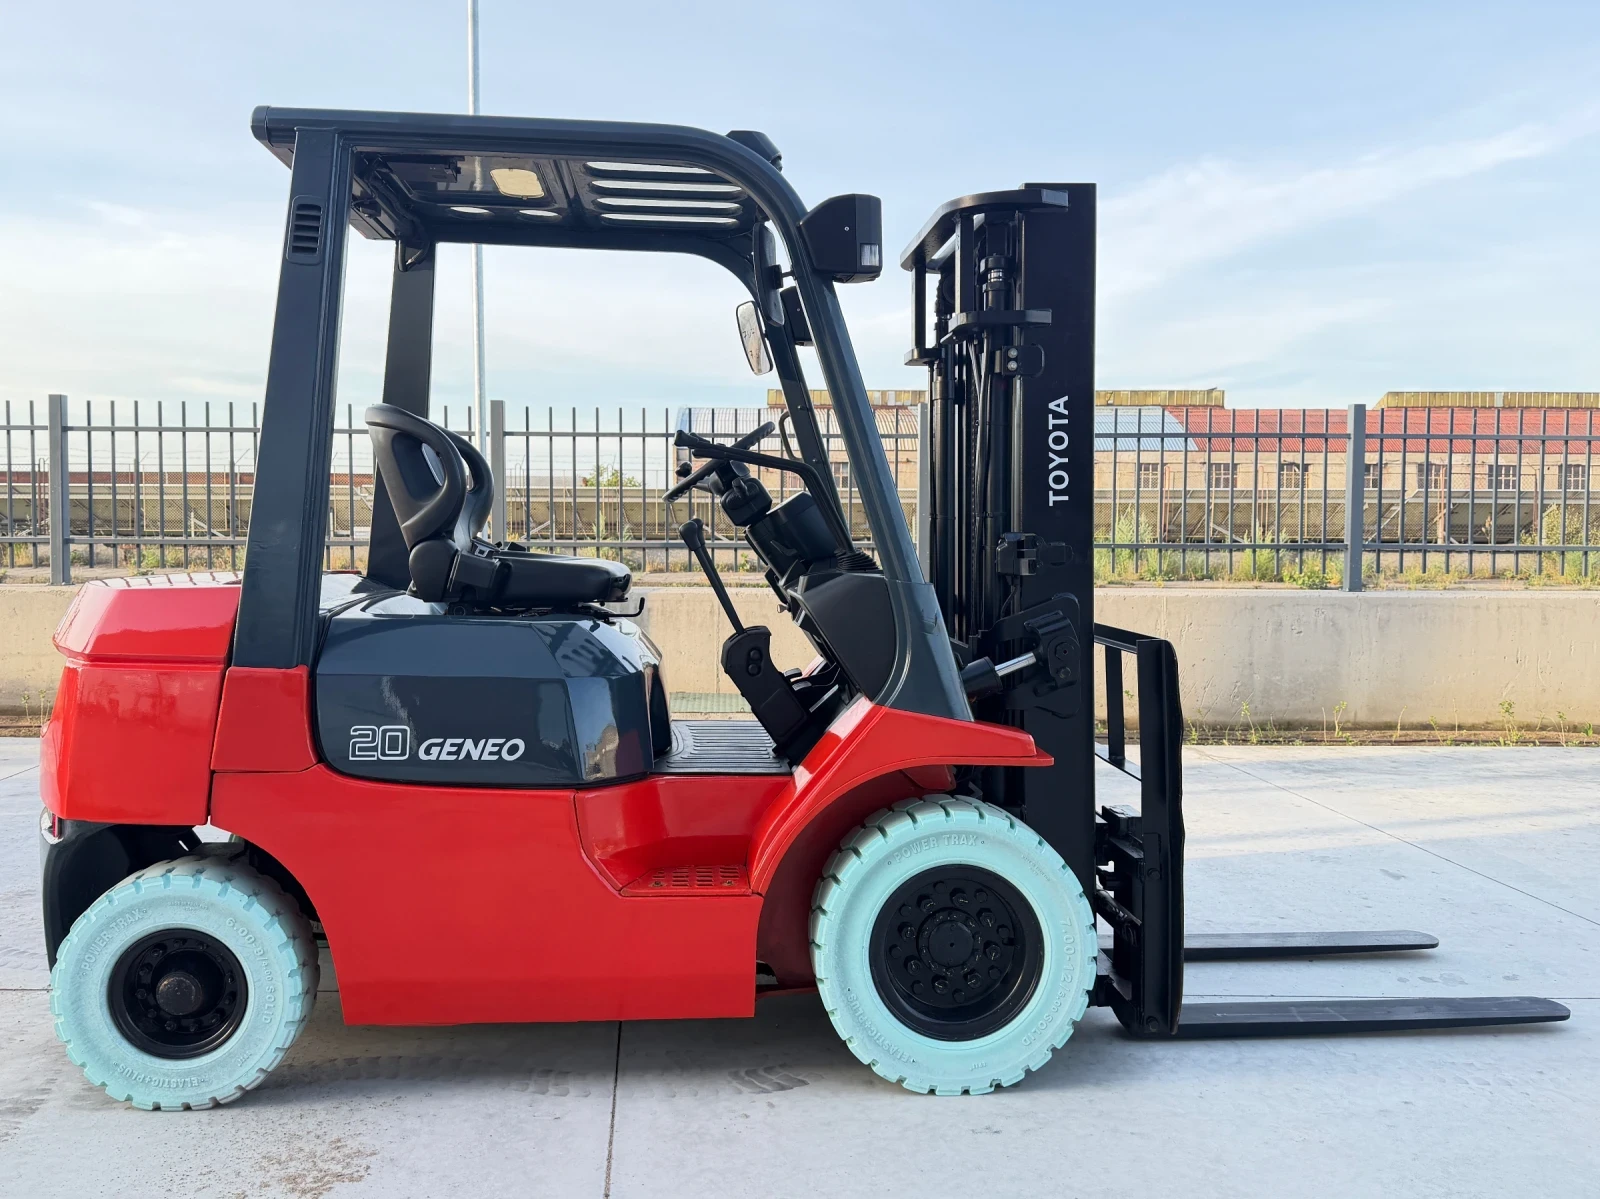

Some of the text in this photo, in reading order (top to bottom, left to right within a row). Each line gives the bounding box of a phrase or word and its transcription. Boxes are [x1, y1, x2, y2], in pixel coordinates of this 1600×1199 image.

[1048, 395, 1069, 507] TOYOTA
[349, 725, 526, 762] 20 GENEO
[892, 834, 979, 863] POWER TRAX
[81, 908, 142, 971] POWER TRAX
[262, 985, 276, 1024] SOLID
[1021, 1013, 1053, 1046] SOLID
